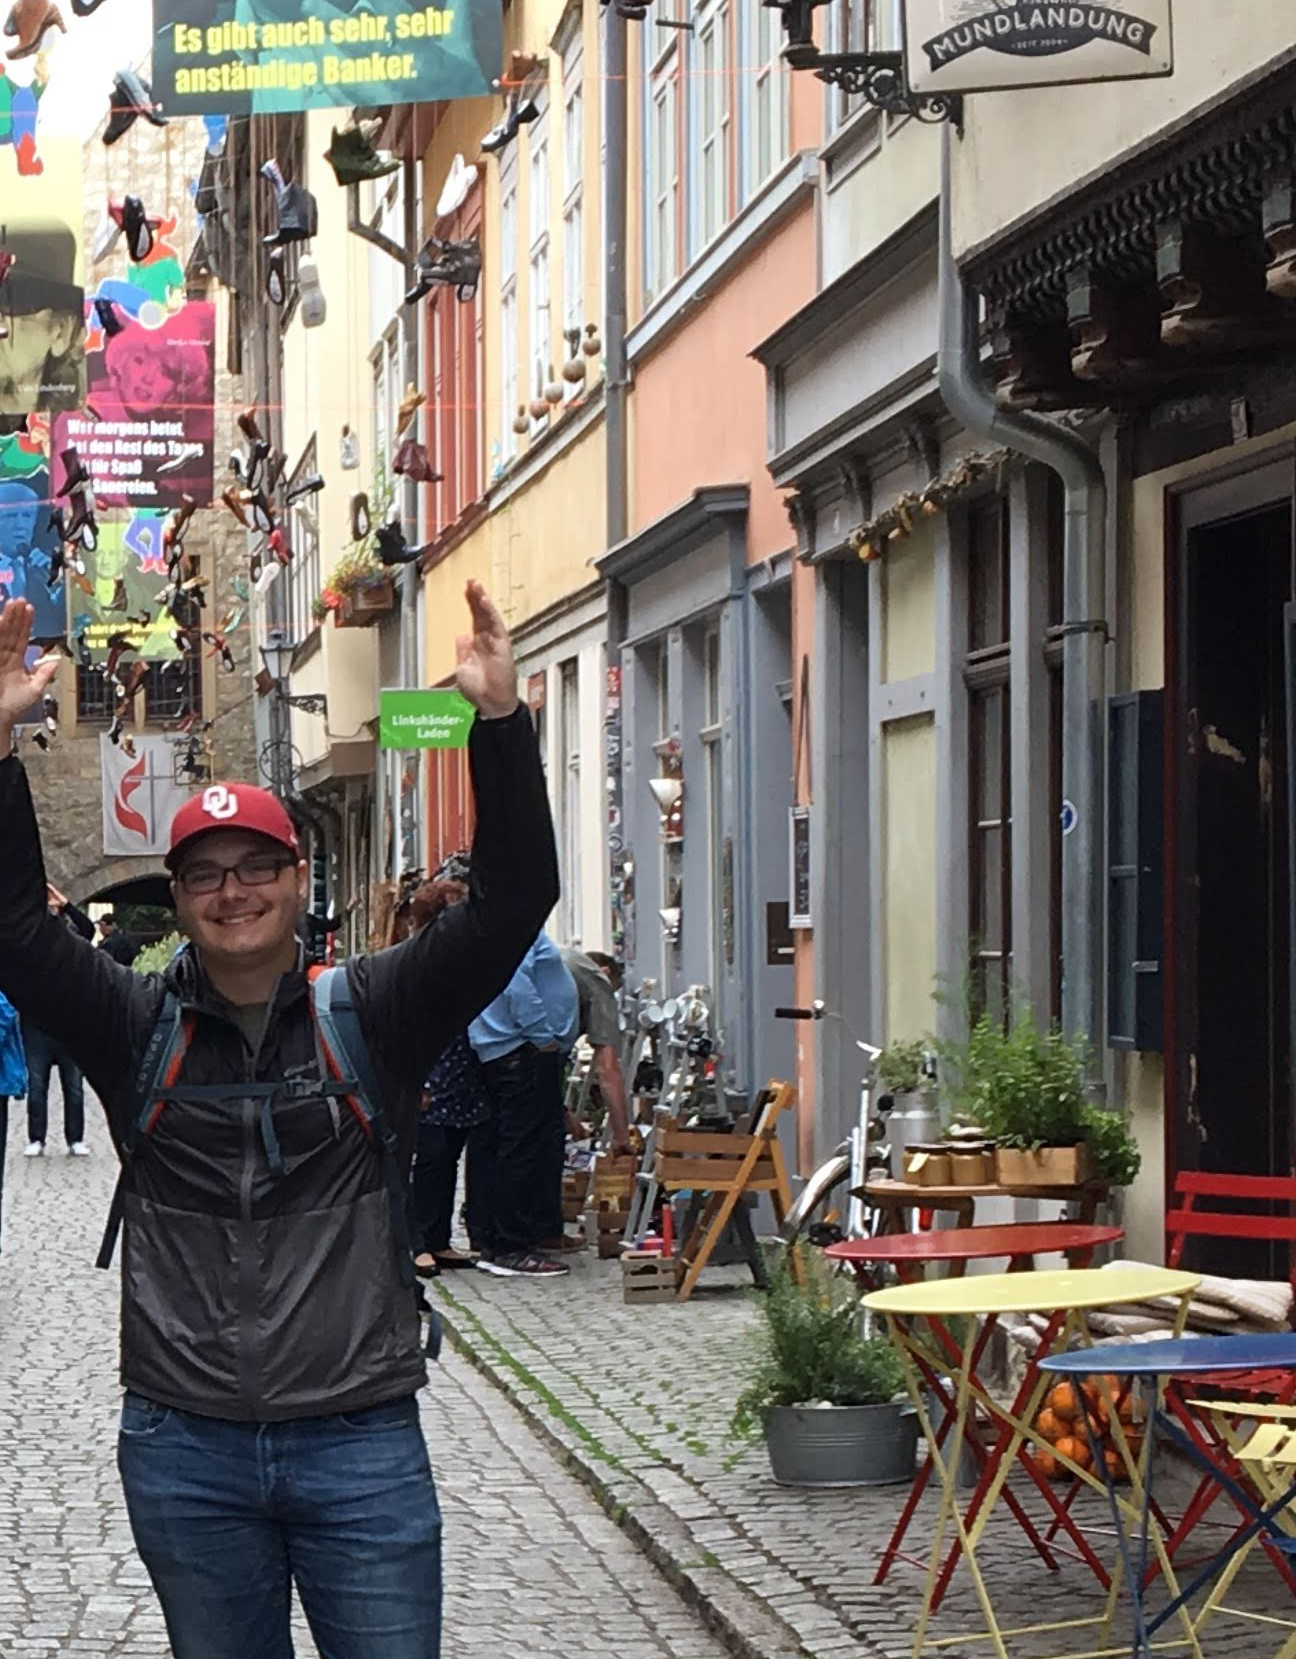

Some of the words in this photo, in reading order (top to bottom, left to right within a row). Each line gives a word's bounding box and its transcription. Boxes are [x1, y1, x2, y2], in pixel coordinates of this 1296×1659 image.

[174, 23, 202, 53] Es
[207, 20, 257, 55] gibt
[262, 16, 324, 48] auch
[330, 12, 392, 47] sehr,
[395, 7, 454, 39] sehr
[932, 8, 1145, 60] MUNDLANDUNG
[175, 56, 317, 93] anständige
[323, 53, 417, 84] Banker.
[67, 419, 94, 435] Wer
[95, 421, 149, 437] morgens
[89, 439, 113, 455] den
[114, 440, 142, 455] Rest
[143, 440, 166, 455] des
[417, 727, 451, 739] Laden
[202, 785, 238, 819] OU
